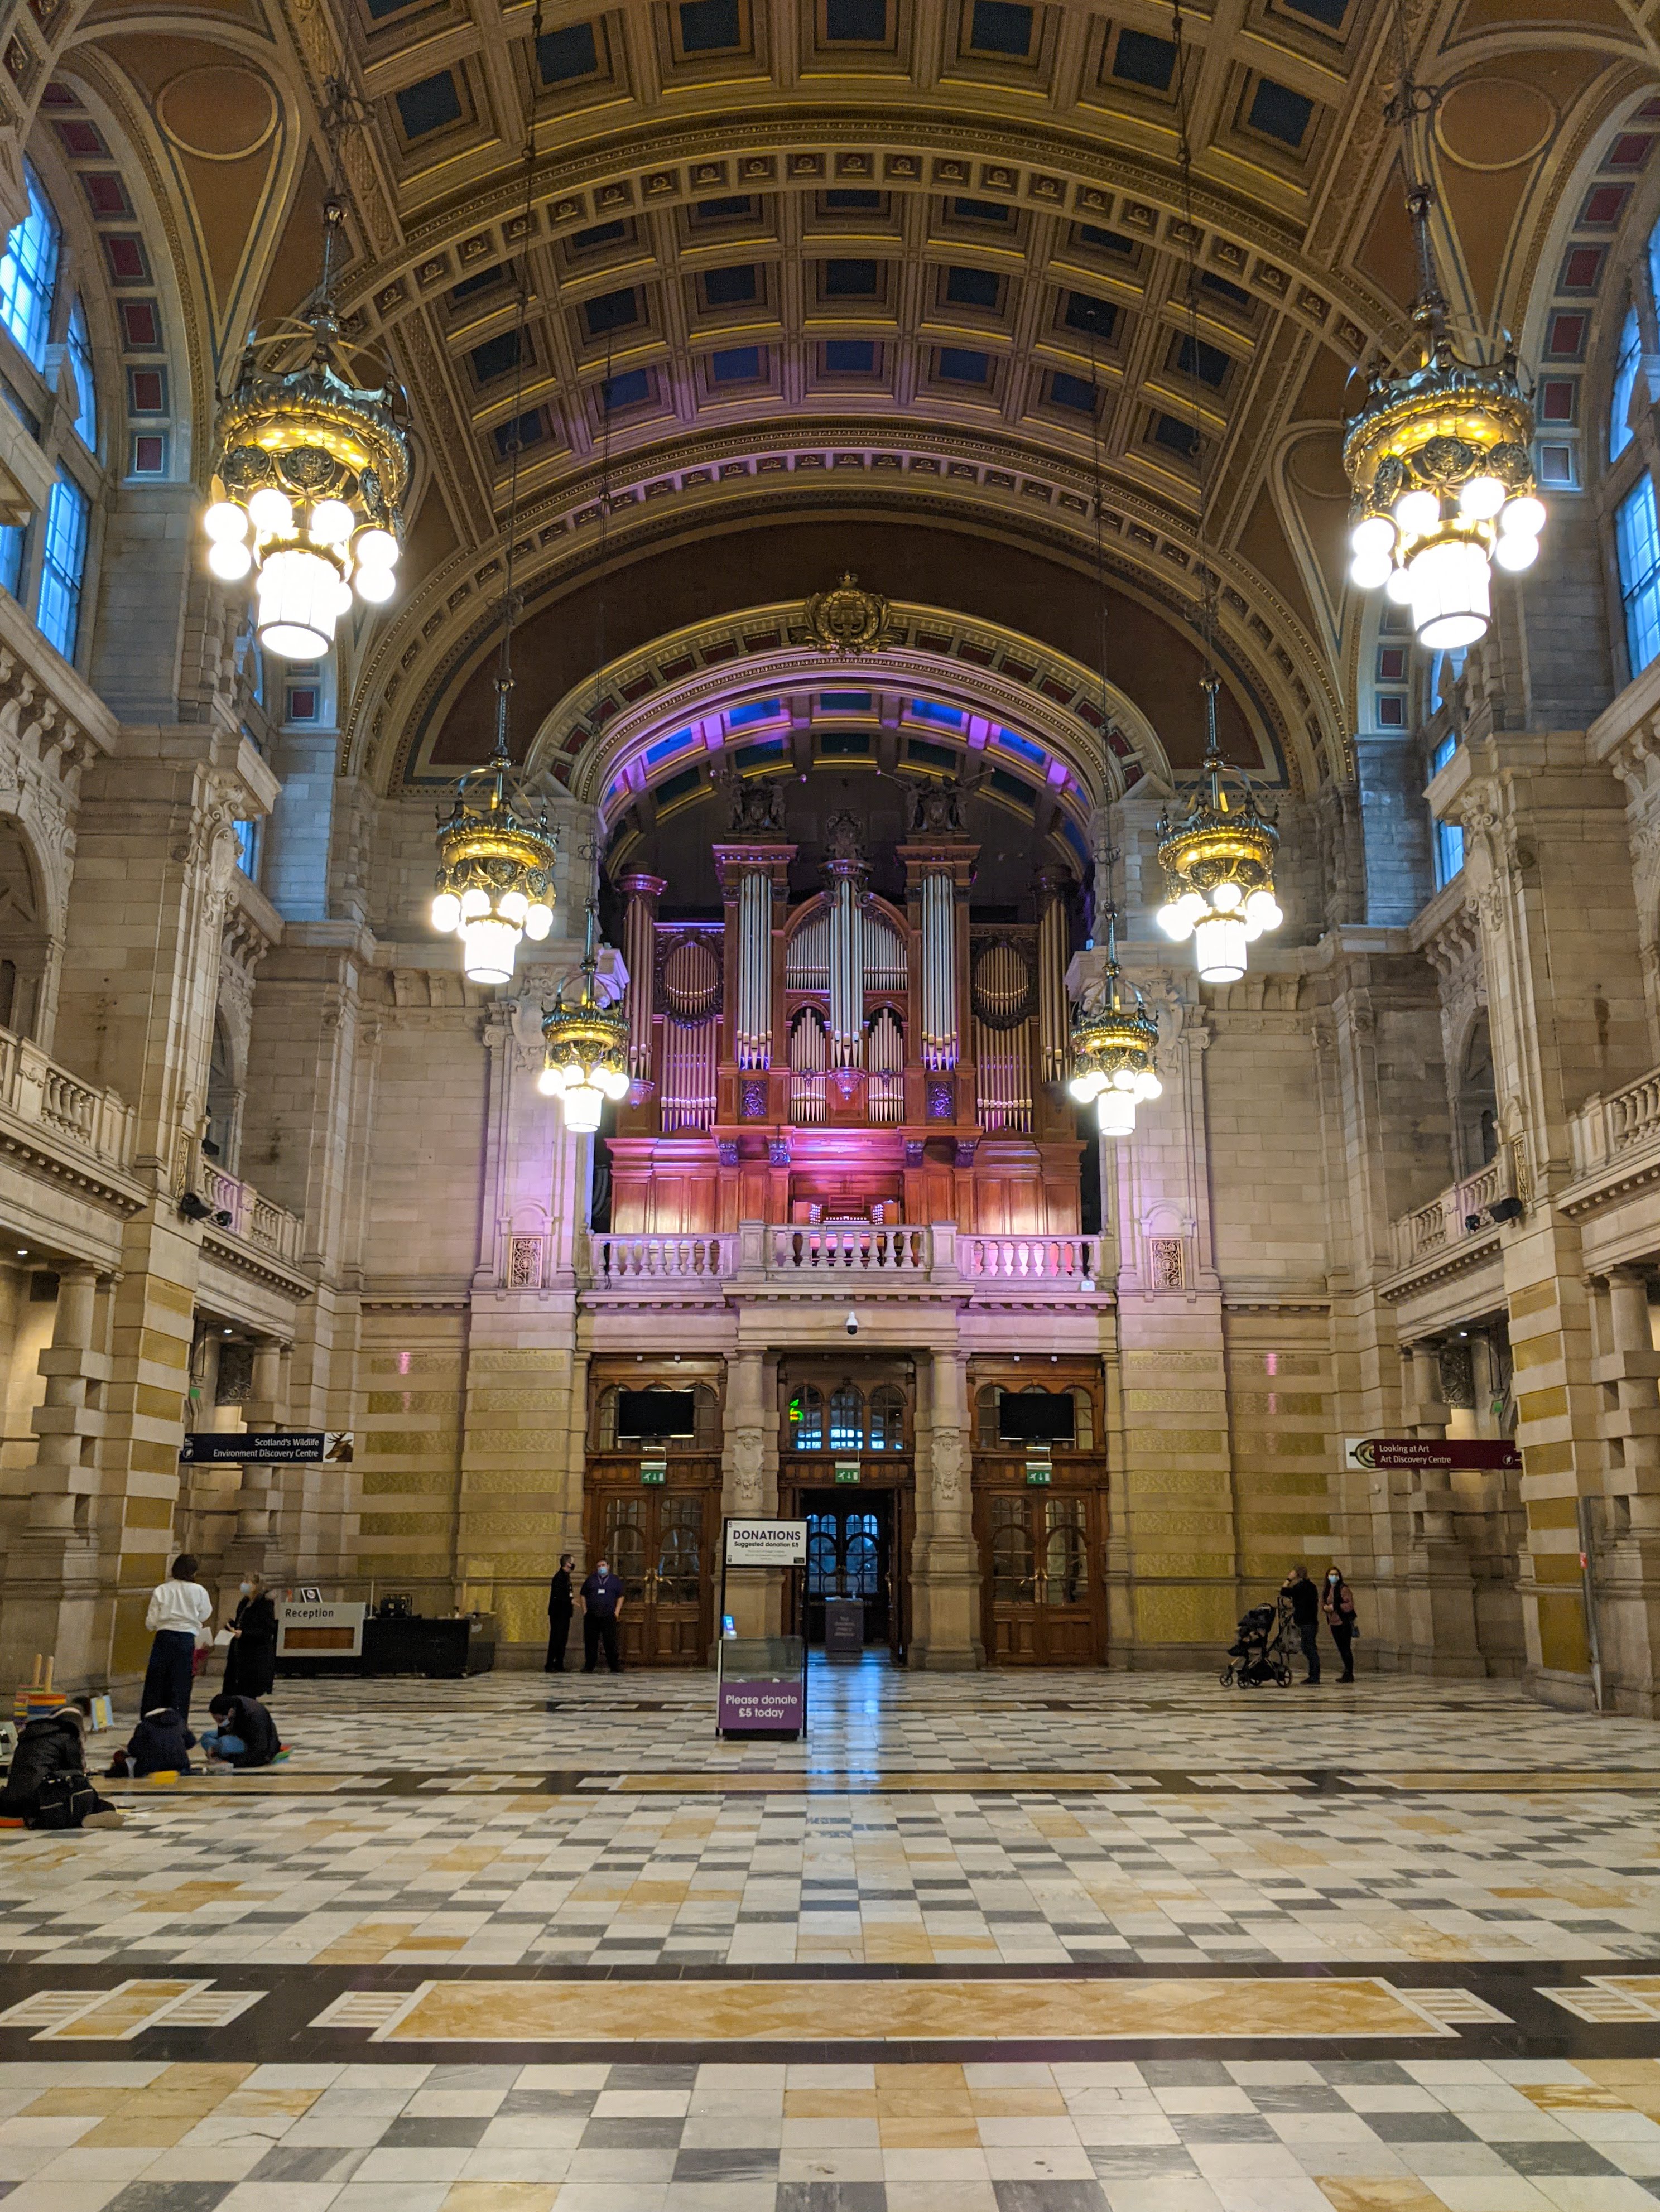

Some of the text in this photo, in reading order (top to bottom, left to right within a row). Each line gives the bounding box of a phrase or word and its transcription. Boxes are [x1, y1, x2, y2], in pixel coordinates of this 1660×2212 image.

[254, 1438, 320, 1446] Scotland's Wildlife
[1379, 1444, 1408, 1453] Looking
[259, 1449, 294, 1458] Discovery
[1393, 1456, 1427, 1464] Discovery
[733, 1530, 801, 1540] DONATIONS
[285, 1608, 334, 1619] Reception
[726, 1695, 797, 1704] Please donate
[739, 1708, 785, 1719] £5 today
